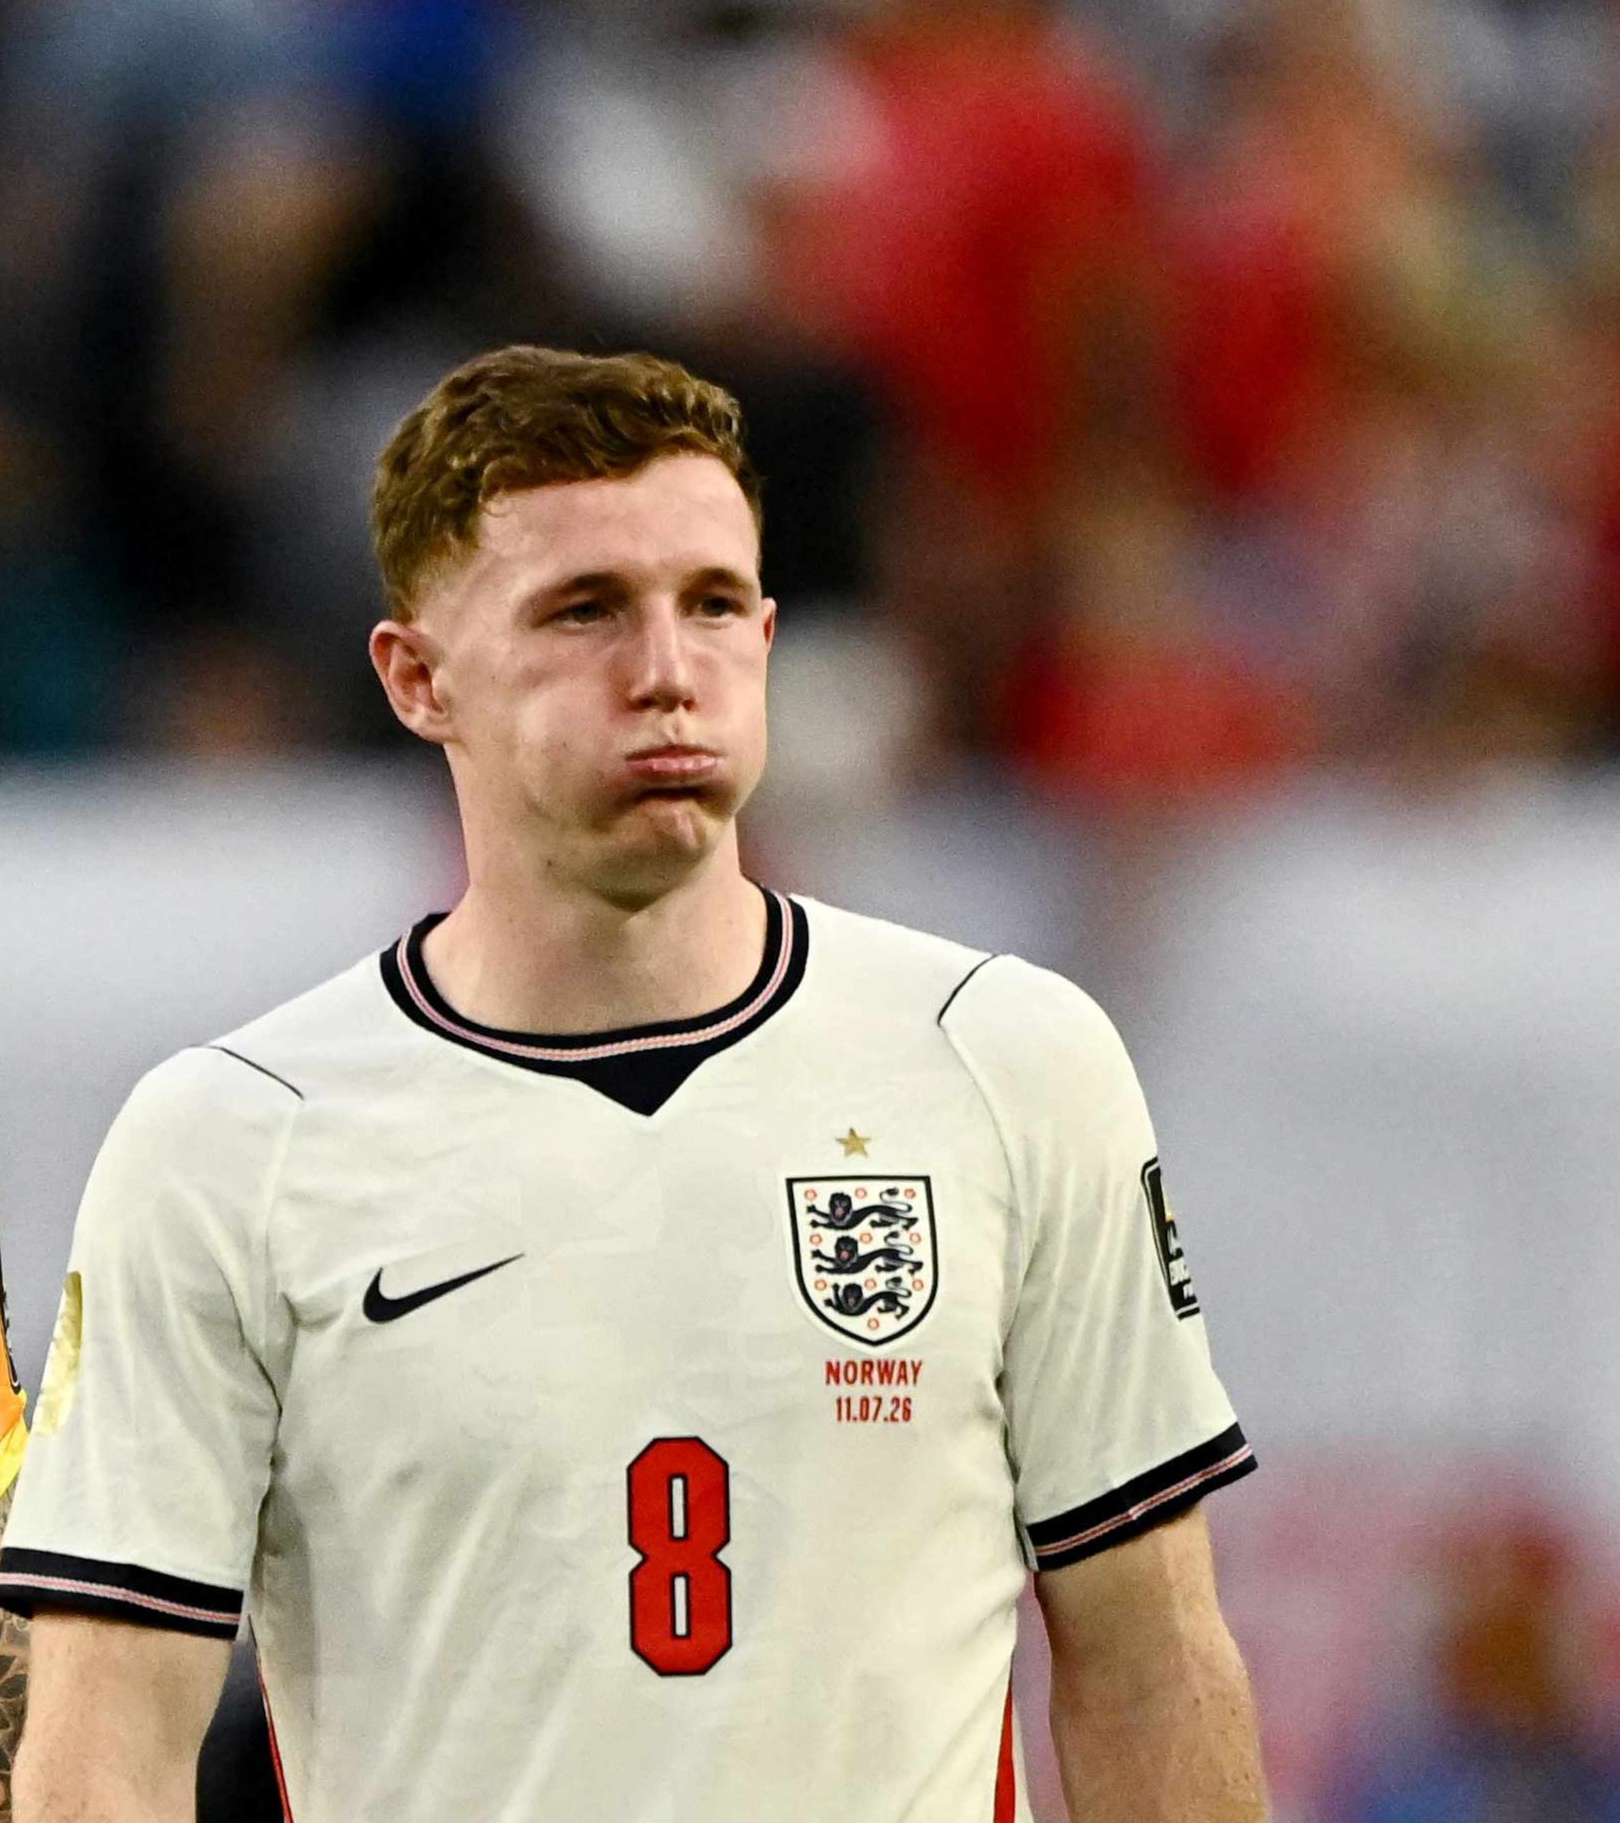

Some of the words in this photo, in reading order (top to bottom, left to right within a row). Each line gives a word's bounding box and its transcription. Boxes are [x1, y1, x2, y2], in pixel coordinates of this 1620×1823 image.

[825, 1359, 922, 1386] NORWAY
[836, 1396, 913, 1422] 11.07.26
[626, 1436, 733, 1678] 8
